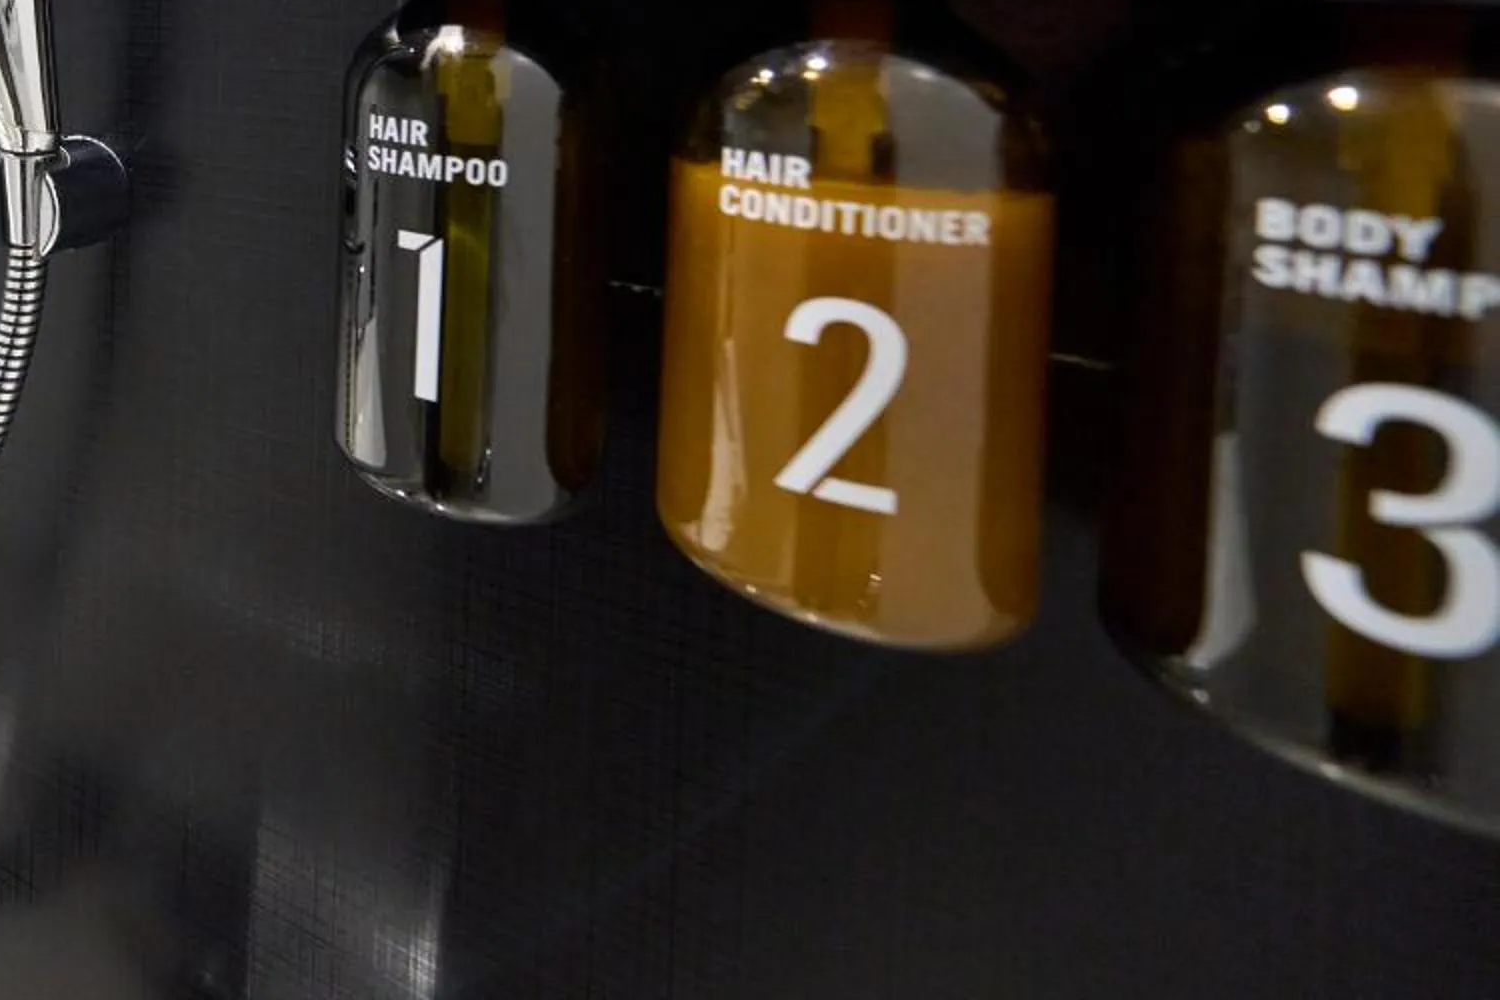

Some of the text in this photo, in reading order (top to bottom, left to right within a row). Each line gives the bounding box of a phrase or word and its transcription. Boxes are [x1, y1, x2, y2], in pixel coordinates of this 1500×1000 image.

[369, 114, 428, 146] HAIR
[368, 146, 508, 187] SHAMPOO
[721, 147, 812, 188] HAIR
[719, 187, 990, 246] CONDITIONER
[1254, 198, 1442, 261] BODY
[398, 230, 444, 402] 1
[774, 297, 909, 516] 2
[1300, 382, 1500, 658] 3
